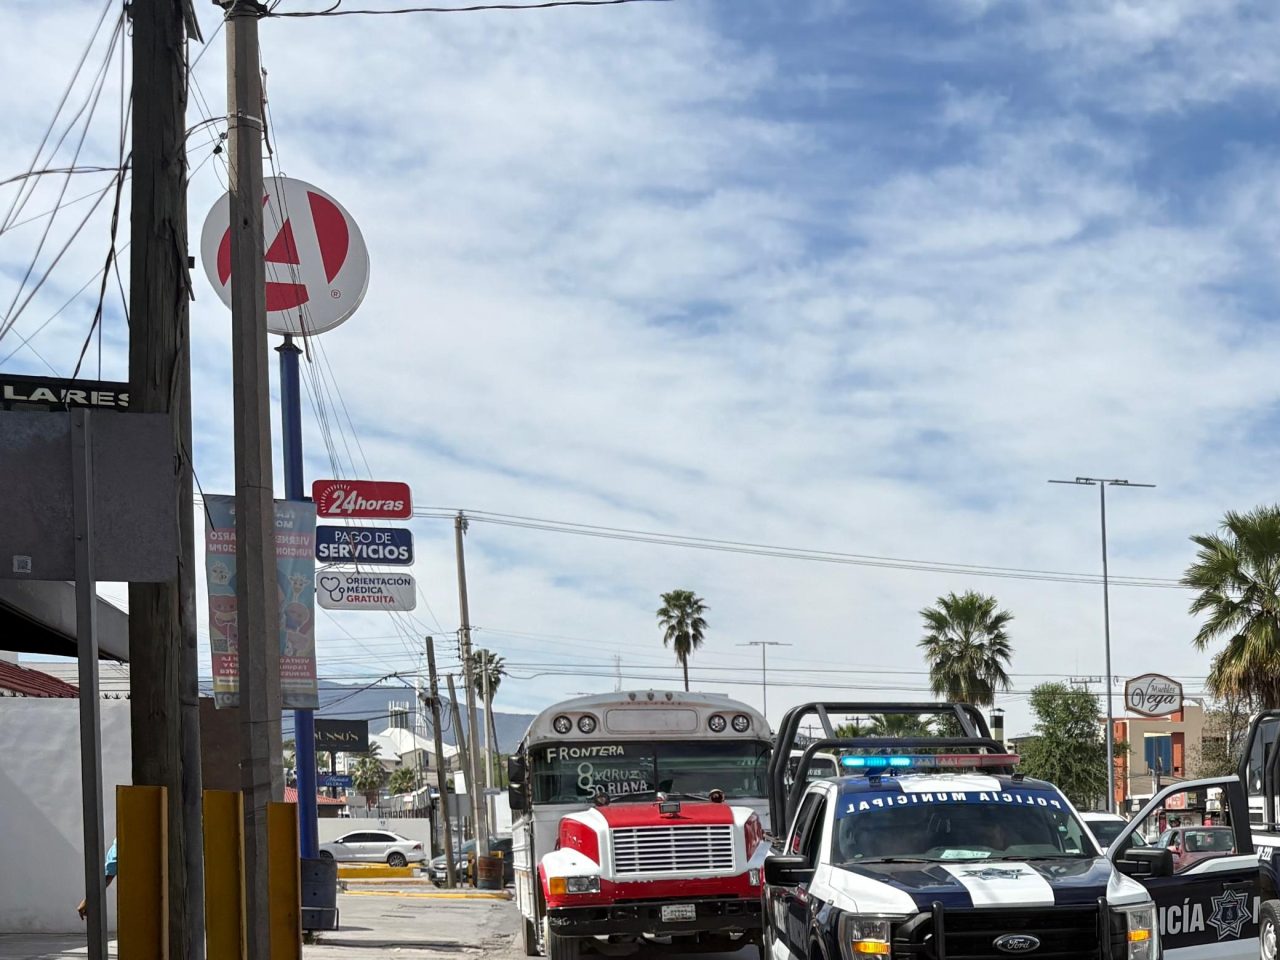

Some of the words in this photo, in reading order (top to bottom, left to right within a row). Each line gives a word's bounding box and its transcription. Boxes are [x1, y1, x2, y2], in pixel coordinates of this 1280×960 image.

[335, 531, 372, 543] PAGO
[375, 533, 392, 543] DE
[319, 543, 409, 559] SERVICIOS
[346, 577, 411, 586] ORIENTACIÓN
[346, 586, 383, 594] MÉDICA
[346, 595, 395, 604] GRATUITA
[546, 745, 625, 763] FRONTERA
[1159, 898, 1205, 936] ICÍA
